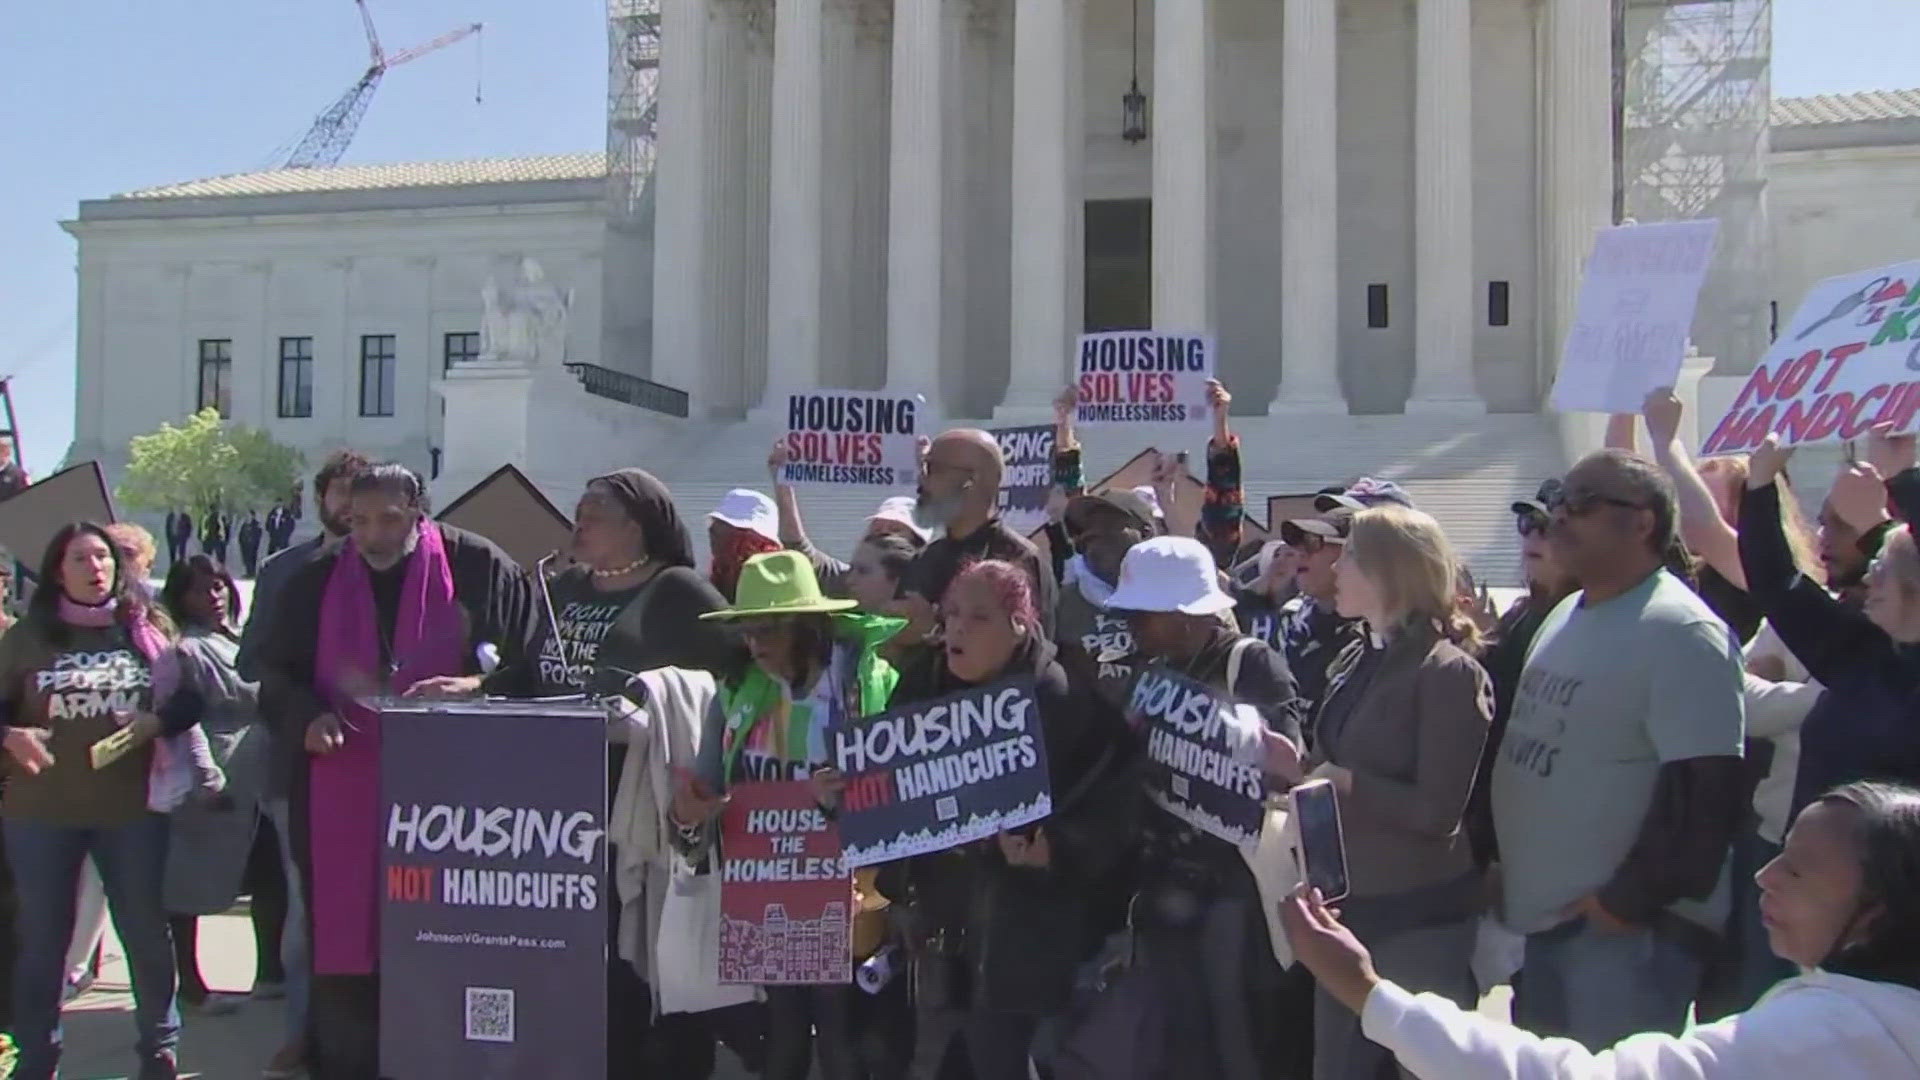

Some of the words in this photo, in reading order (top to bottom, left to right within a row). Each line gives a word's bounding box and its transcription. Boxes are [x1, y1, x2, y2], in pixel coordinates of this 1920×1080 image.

[1081, 337, 1204, 371] HOUSING
[1080, 372, 1174, 402] SOLVES
[1732, 341, 1867, 410] NOT
[789, 395, 915, 435] HOUSING
[1078, 403, 1186, 421] HOMELESSNESS
[787, 431, 883, 466] SOLVES
[785, 463, 894, 485] HOMELESSNESS
[549, 620, 616, 641] OVERTY
[571, 641, 600, 661] THE
[836, 688, 1032, 772] HOUSING
[844, 771, 893, 811] NOT
[896, 735, 1037, 801] HANDCUFFS
[1148, 726, 1262, 801] HANDCUFFS
[387, 803, 605, 864] HOUSING
[746, 809, 828, 833] HOUSE
[770, 835, 806, 854] THE
[723, 858, 848, 881] HOMELESS
[387, 865, 435, 901] NOT
[443, 868, 598, 910] HANDCUFFS
